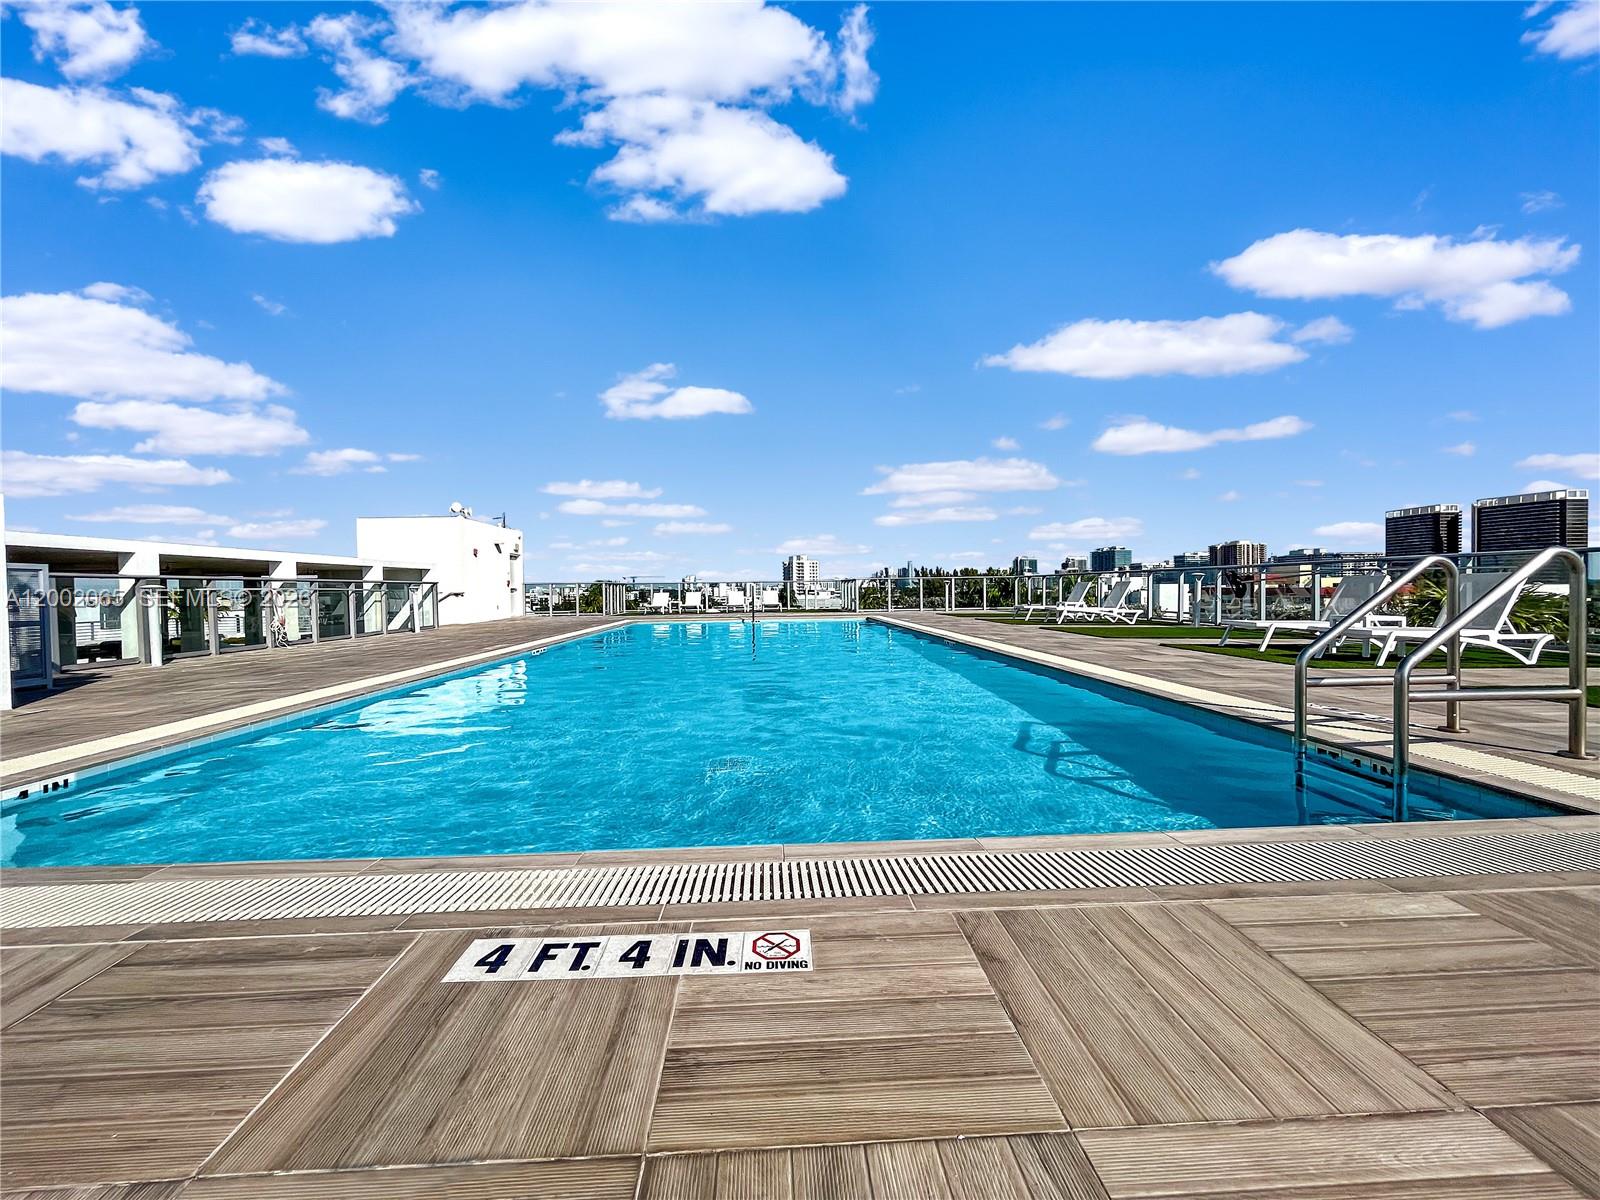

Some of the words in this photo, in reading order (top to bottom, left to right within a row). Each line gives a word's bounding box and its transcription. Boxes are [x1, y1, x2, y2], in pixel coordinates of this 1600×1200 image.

[474, 944, 516, 973] 4
[527, 942, 601, 972] FT.
[619, 940, 652, 969] 4
[672, 938, 737, 967] IN.
[744, 961, 762, 970] NO
[766, 960, 809, 969] DIVING
